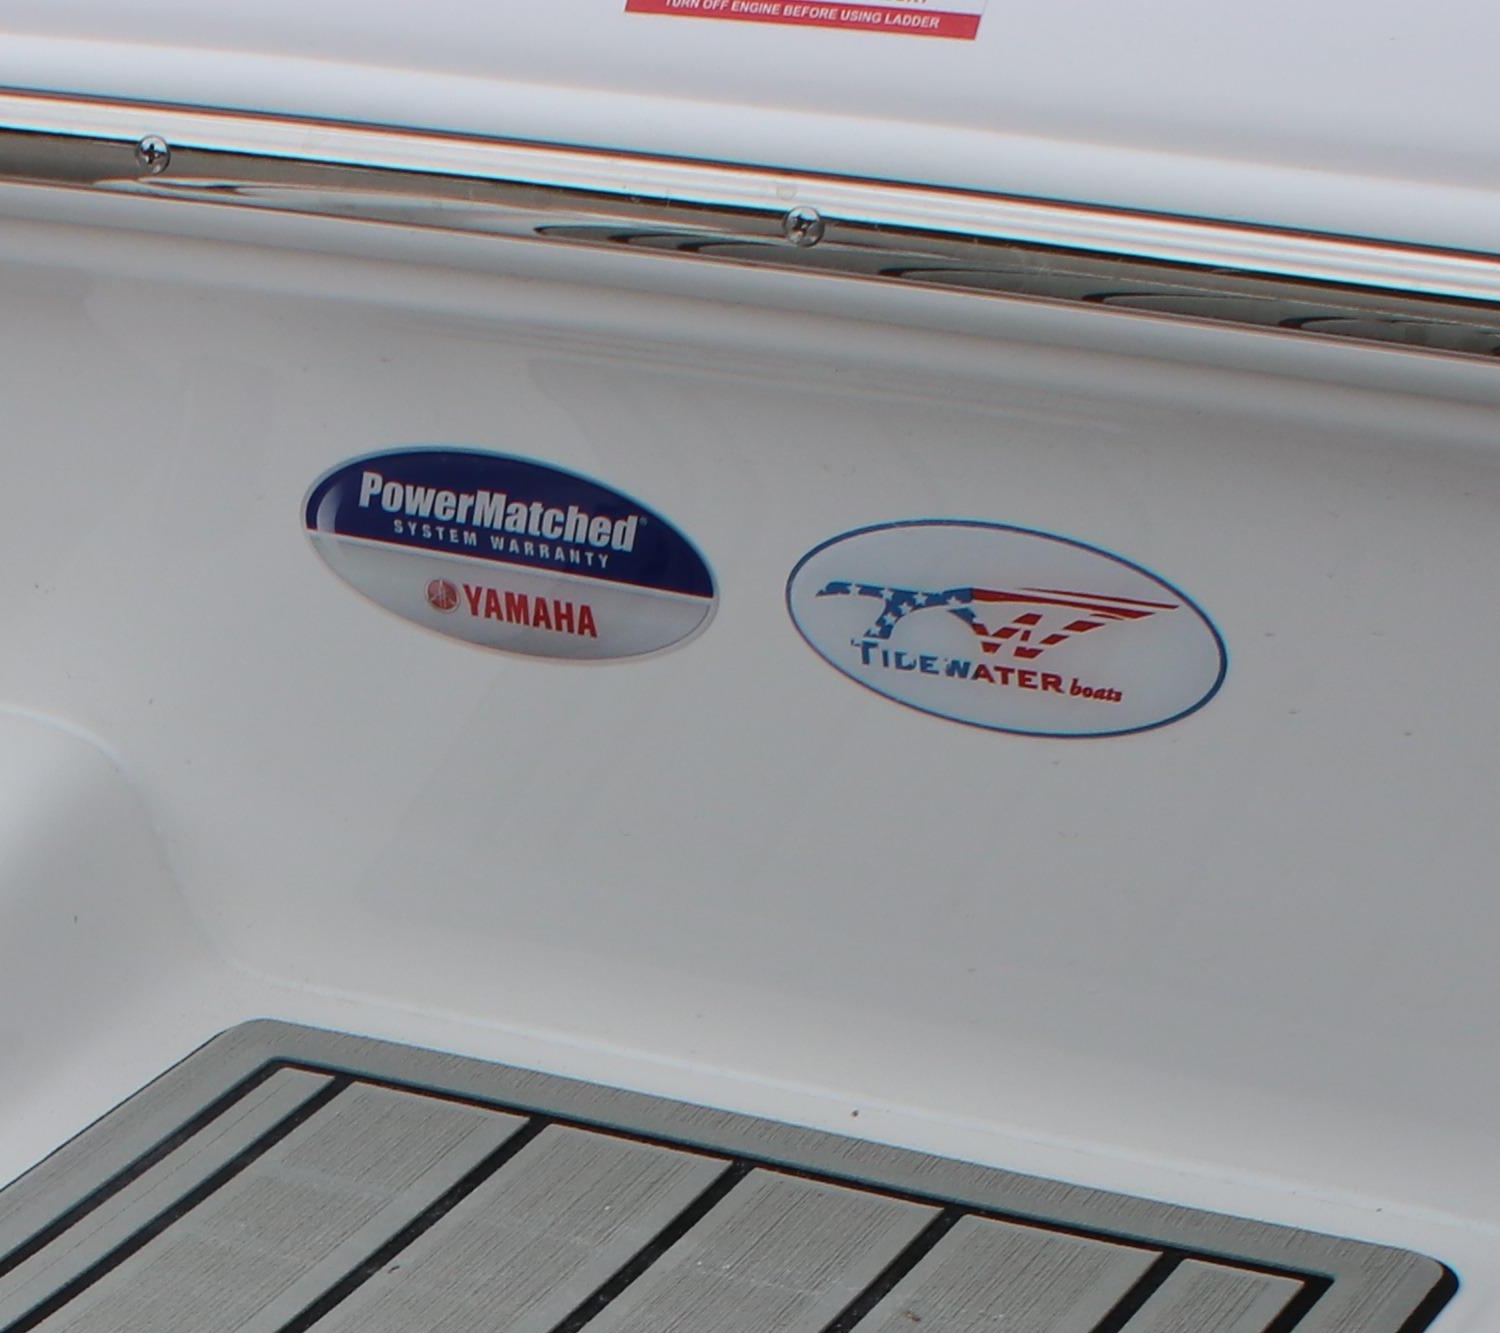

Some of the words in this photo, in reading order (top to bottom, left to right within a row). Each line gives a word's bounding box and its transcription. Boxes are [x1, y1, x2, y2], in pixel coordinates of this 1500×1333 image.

[702, 0, 728, 11] OFF
[730, 3, 780, 15] ENGINE
[783, 6, 837, 20] BEFORE
[840, 11, 882, 23] USING
[884, 13, 940, 28] LADDER
[358, 470, 642, 553] PowerMatched
[393, 519, 477, 547] SYSTEM
[490, 535, 609, 569] WARRANTY
[462, 583, 598, 638] YAMAHA
[850, 639, 1065, 694] TIDEWATER
[1069, 677, 1122, 702] boats
